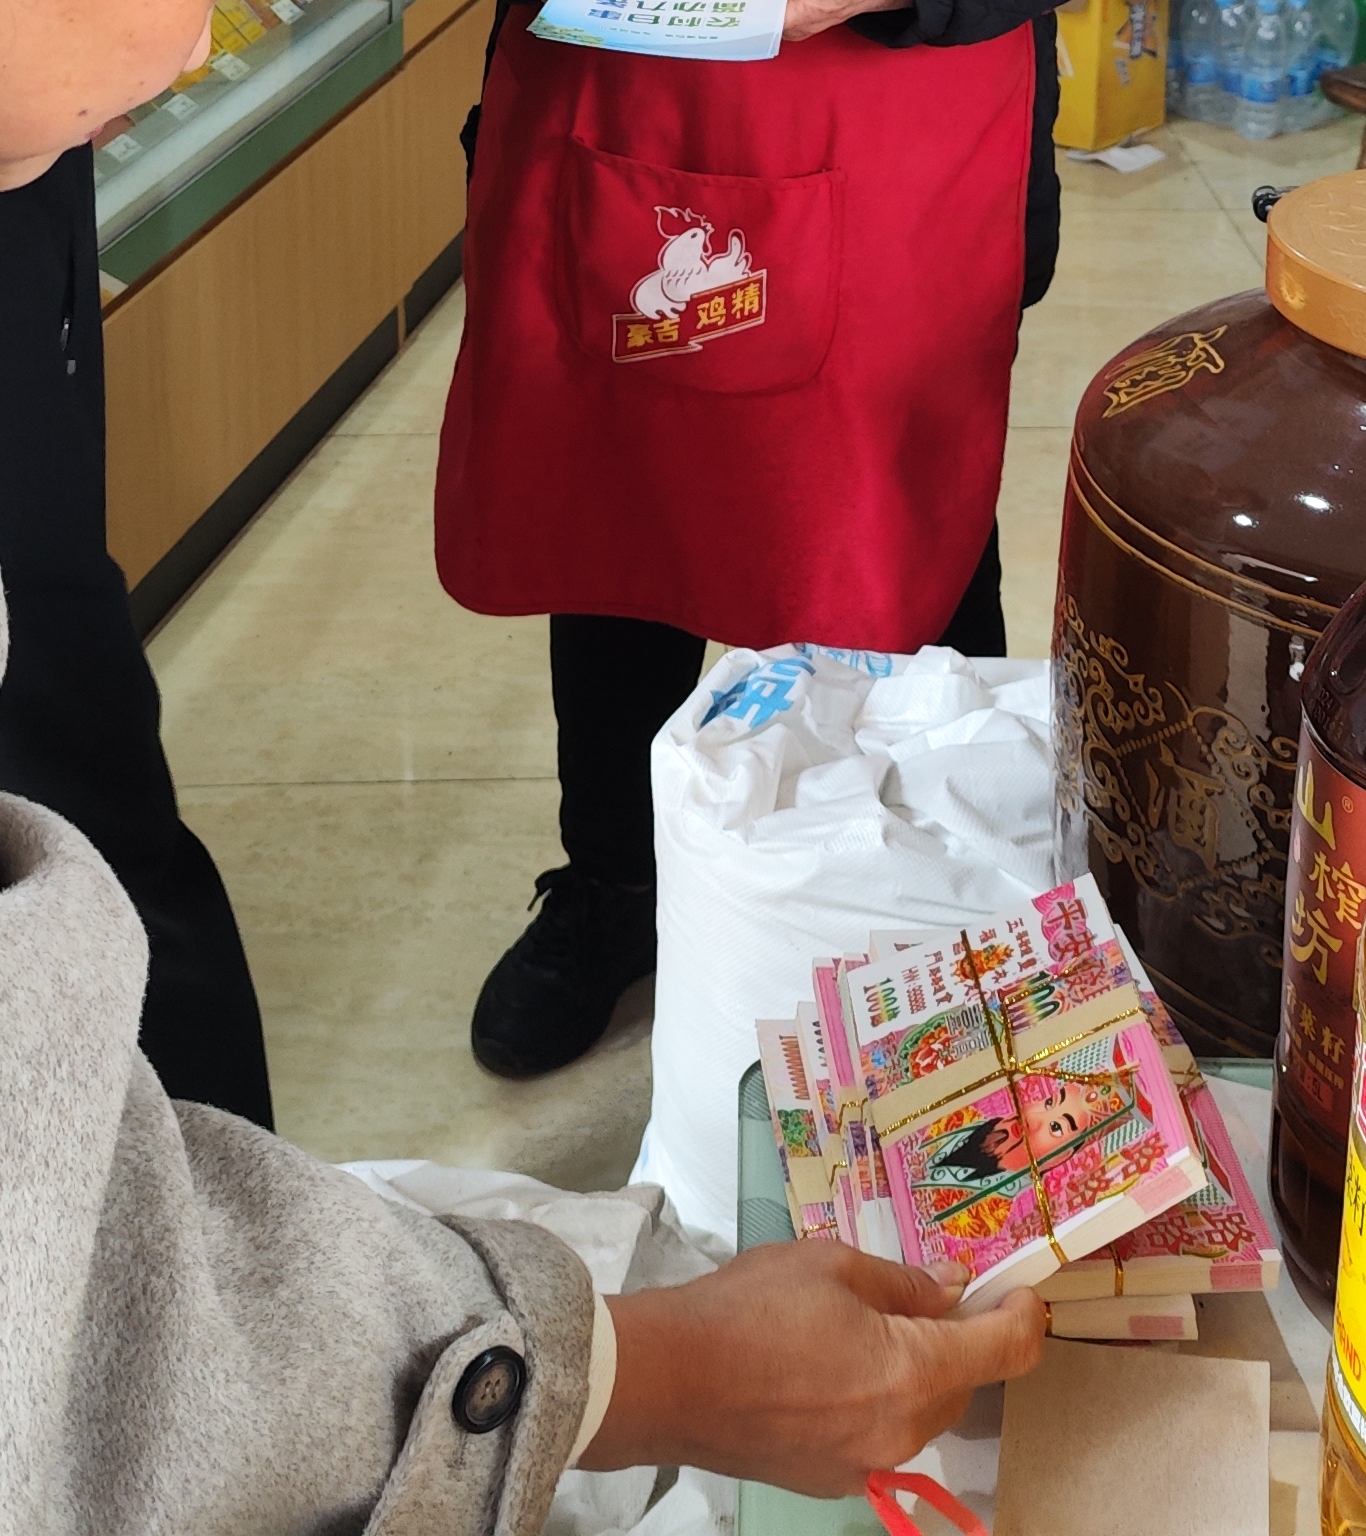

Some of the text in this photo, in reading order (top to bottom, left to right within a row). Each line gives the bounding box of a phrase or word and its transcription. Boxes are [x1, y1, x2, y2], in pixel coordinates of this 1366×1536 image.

[585, 7, 741, 28] 农村白事
[626, 282, 761, 348] 豪吉 鸡精
